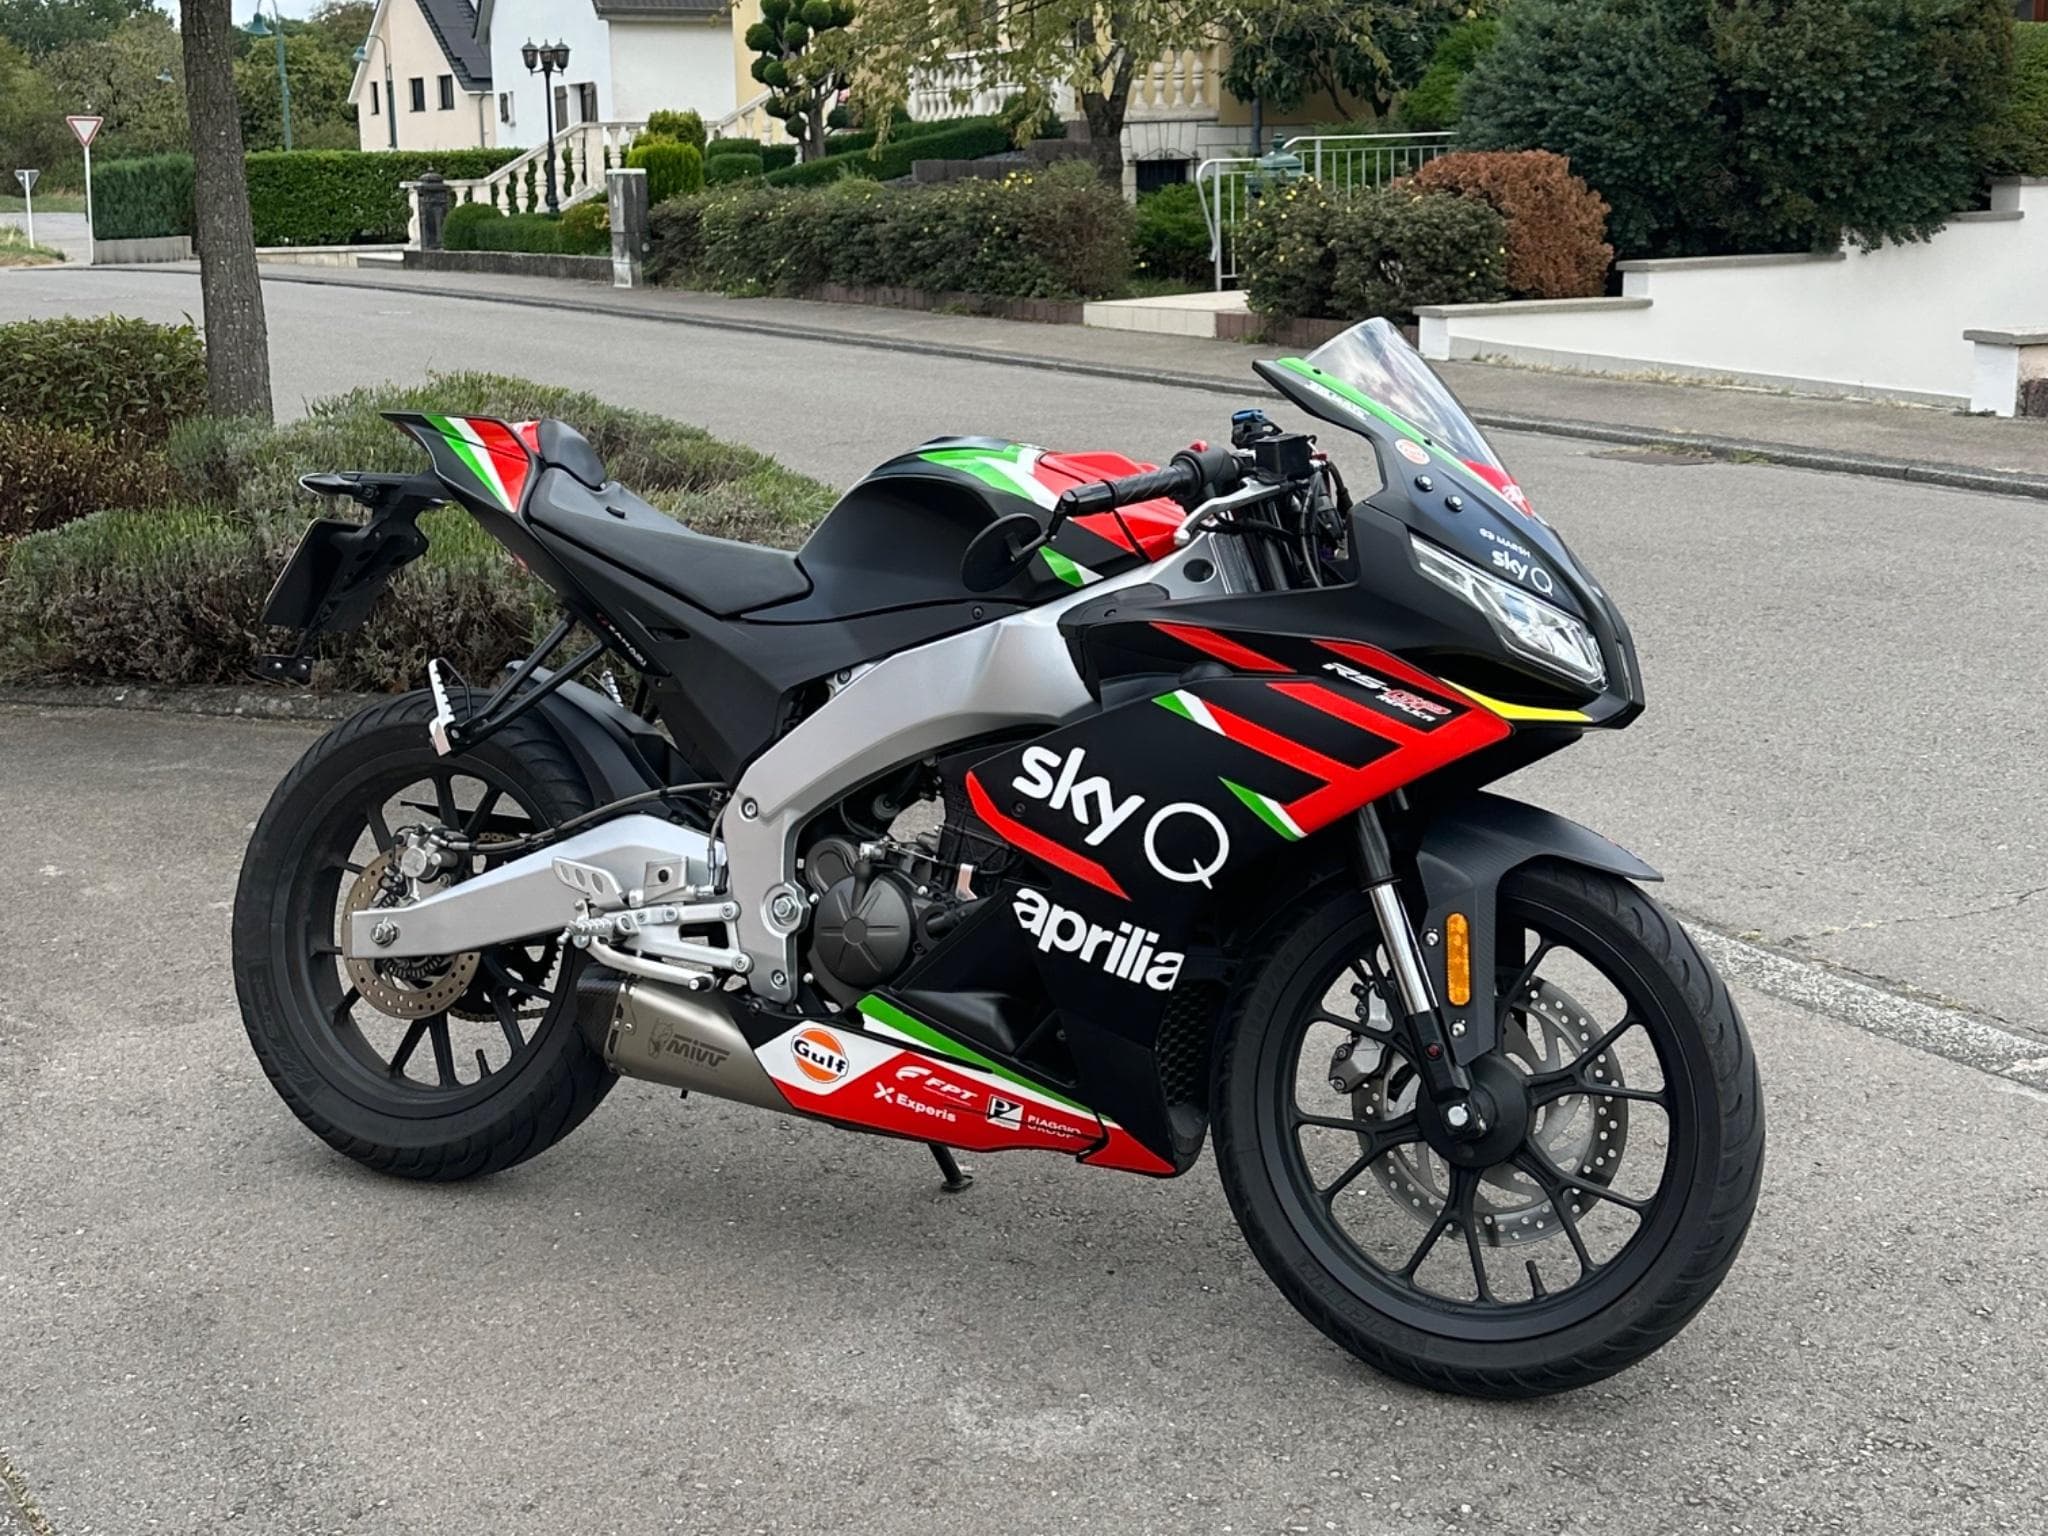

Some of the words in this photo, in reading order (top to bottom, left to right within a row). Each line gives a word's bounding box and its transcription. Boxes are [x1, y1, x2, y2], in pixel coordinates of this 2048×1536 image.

[1491, 550, 1528, 581] sky
[1530, 566, 1553, 597] Q
[1011, 745, 1146, 846] sky
[1143, 801, 1230, 891] Q
[1012, 887, 1186, 992] aprilia
[793, 1038, 847, 1073] Gulf
[896, 1092, 957, 1123] Experis
[924, 1077, 979, 1101] FPT
